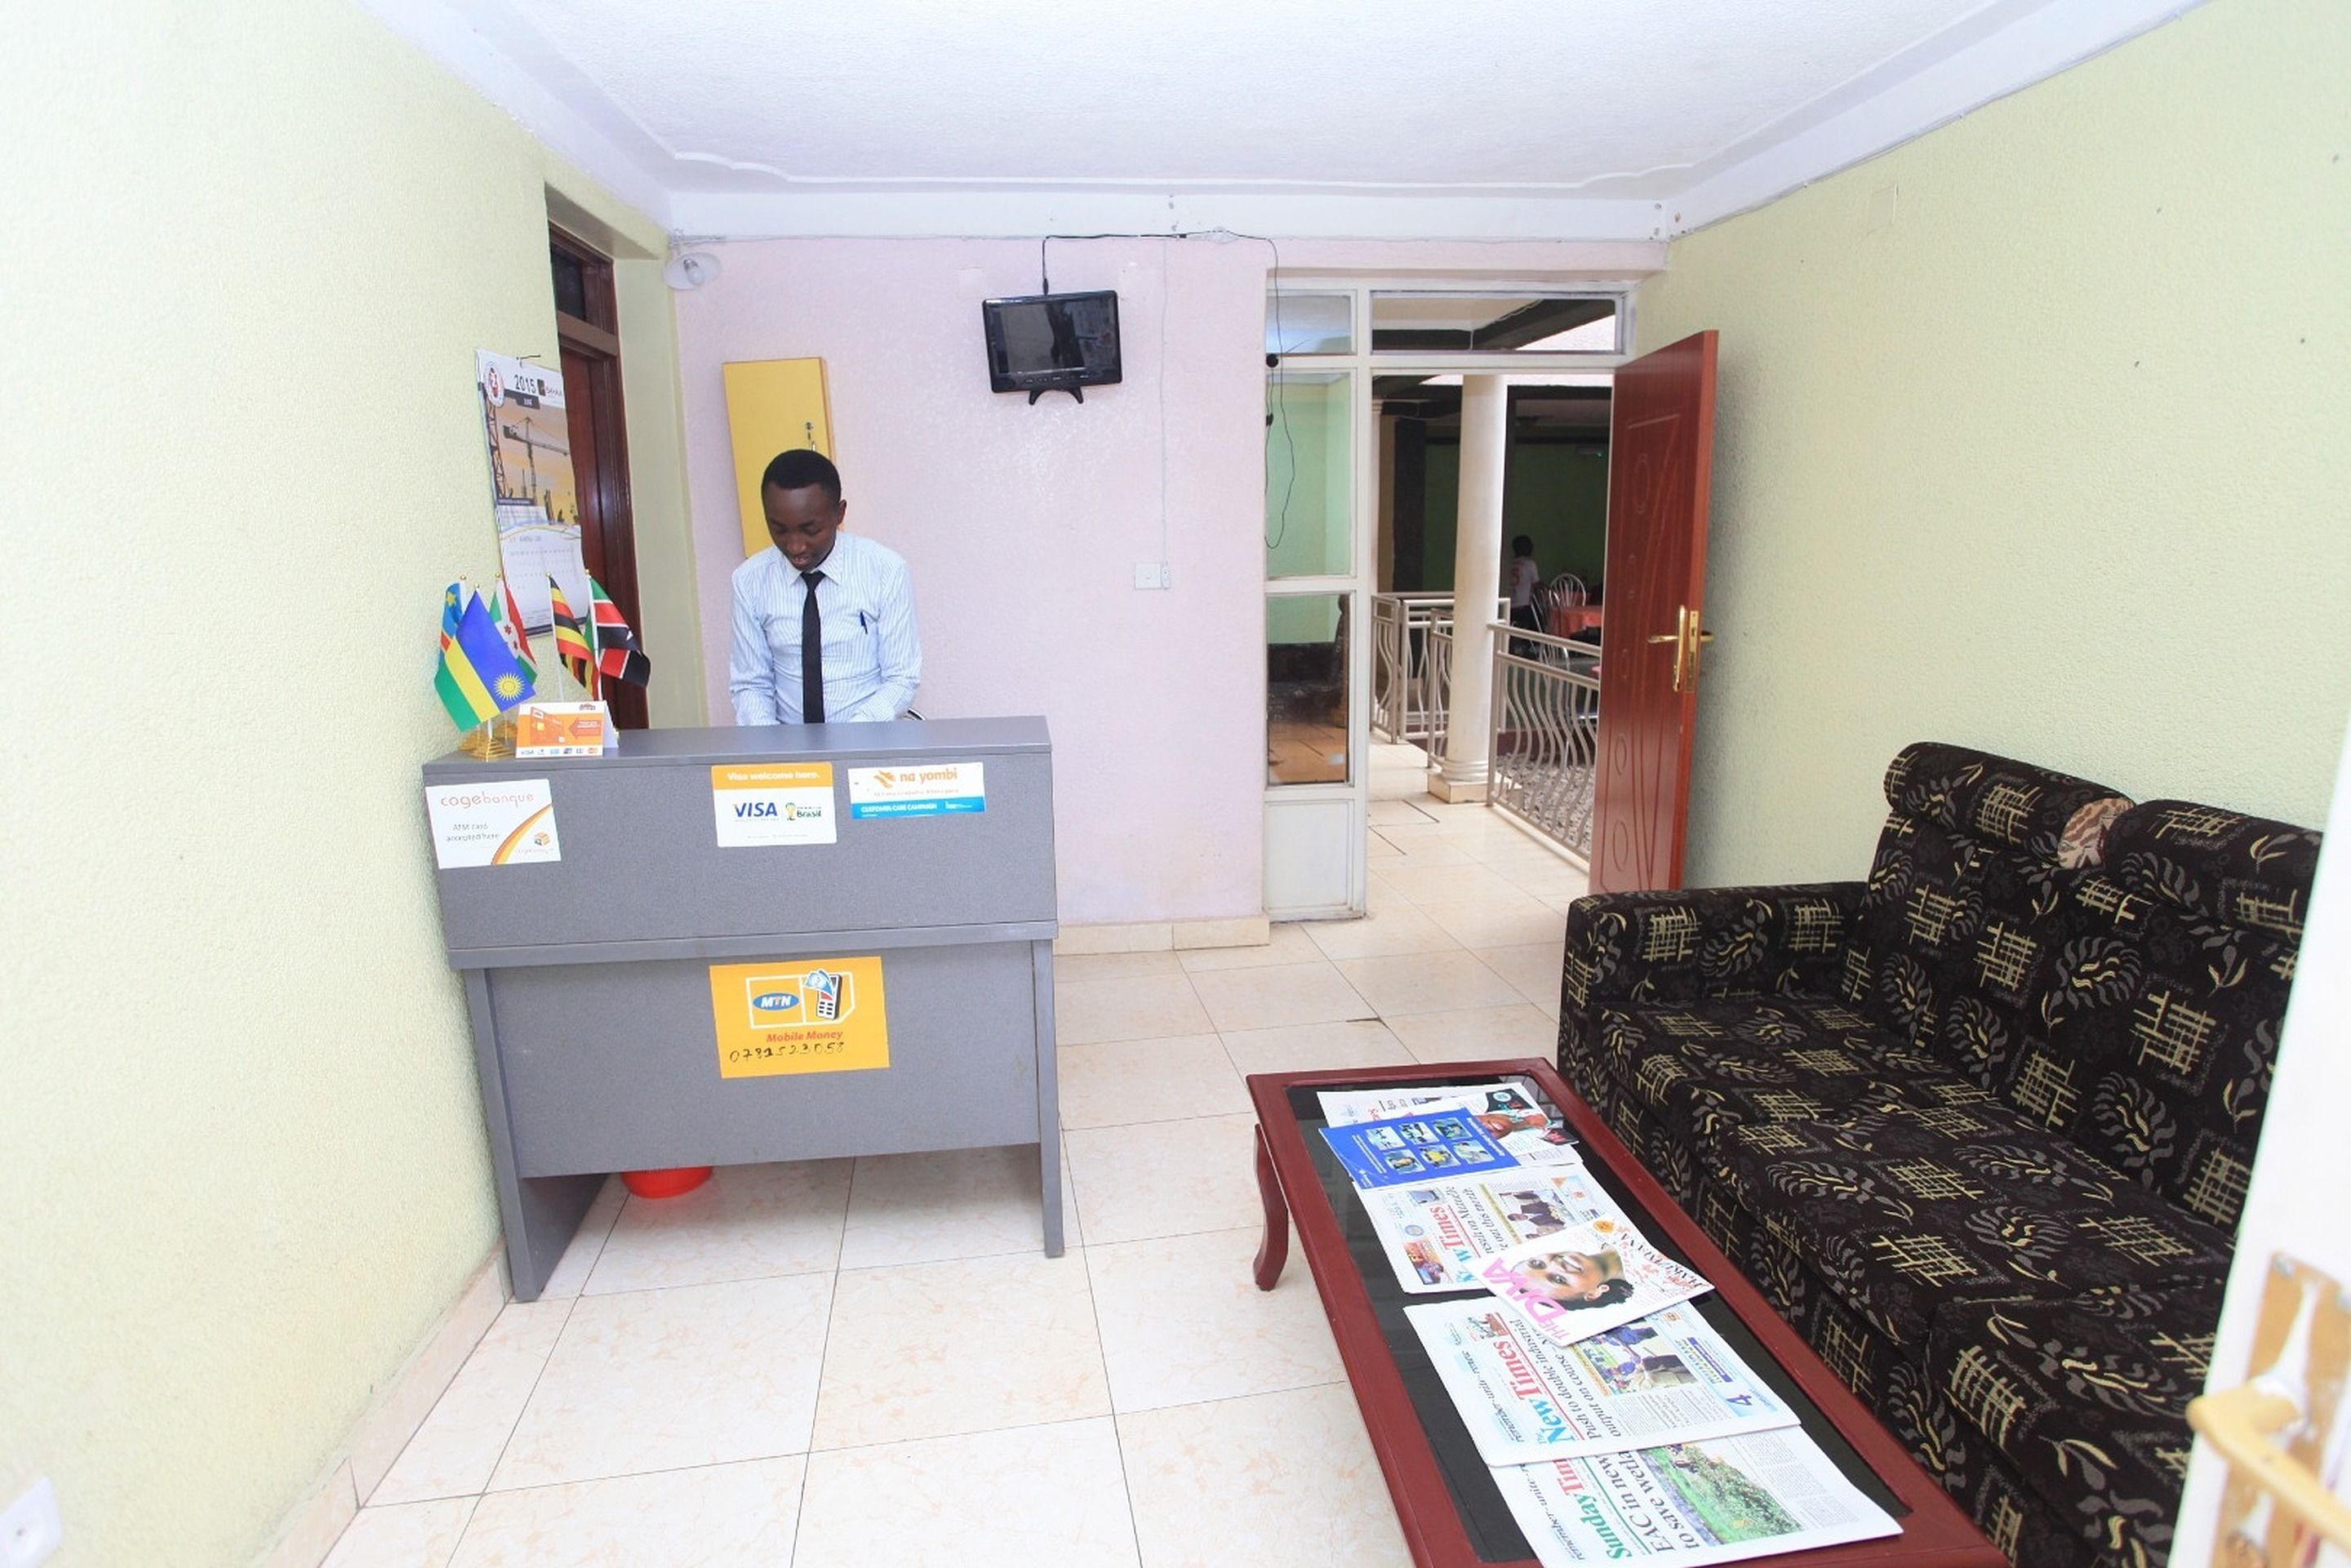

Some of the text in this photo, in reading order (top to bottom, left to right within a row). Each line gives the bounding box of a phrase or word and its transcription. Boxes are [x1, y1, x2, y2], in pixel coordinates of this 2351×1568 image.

[514, 374, 536, 393] 2015
[727, 771, 749, 780] Visa
[749, 771, 794, 780] welcome
[900, 767, 958, 784] na yombi
[441, 791, 535, 809] cogebanque
[732, 802, 778, 817] VISA
[796, 809, 822, 818] Brasil
[760, 995, 792, 1008] MTN
[766, 1030, 843, 1043] Mobile Money
[1482, 1257, 1567, 1323] DIVA
[1538, 1320, 1571, 1340] THE
[1508, 1319, 1549, 1363] industrial
[1553, 1354, 1584, 1386] course
[1540, 1365, 1573, 1400] double
[1578, 1388, 1595, 1401] on
[1725, 1394, 1753, 1406] 4
[1566, 1401, 1582, 1412] to
[1571, 1414, 1603, 1440] Push
[1588, 1403, 1623, 1437] output
[1617, 1493, 1642, 1510] in
[1648, 1497, 1685, 1530] save
[1627, 1513, 1677, 1552] EAC
[1675, 1533, 1701, 1549] to
